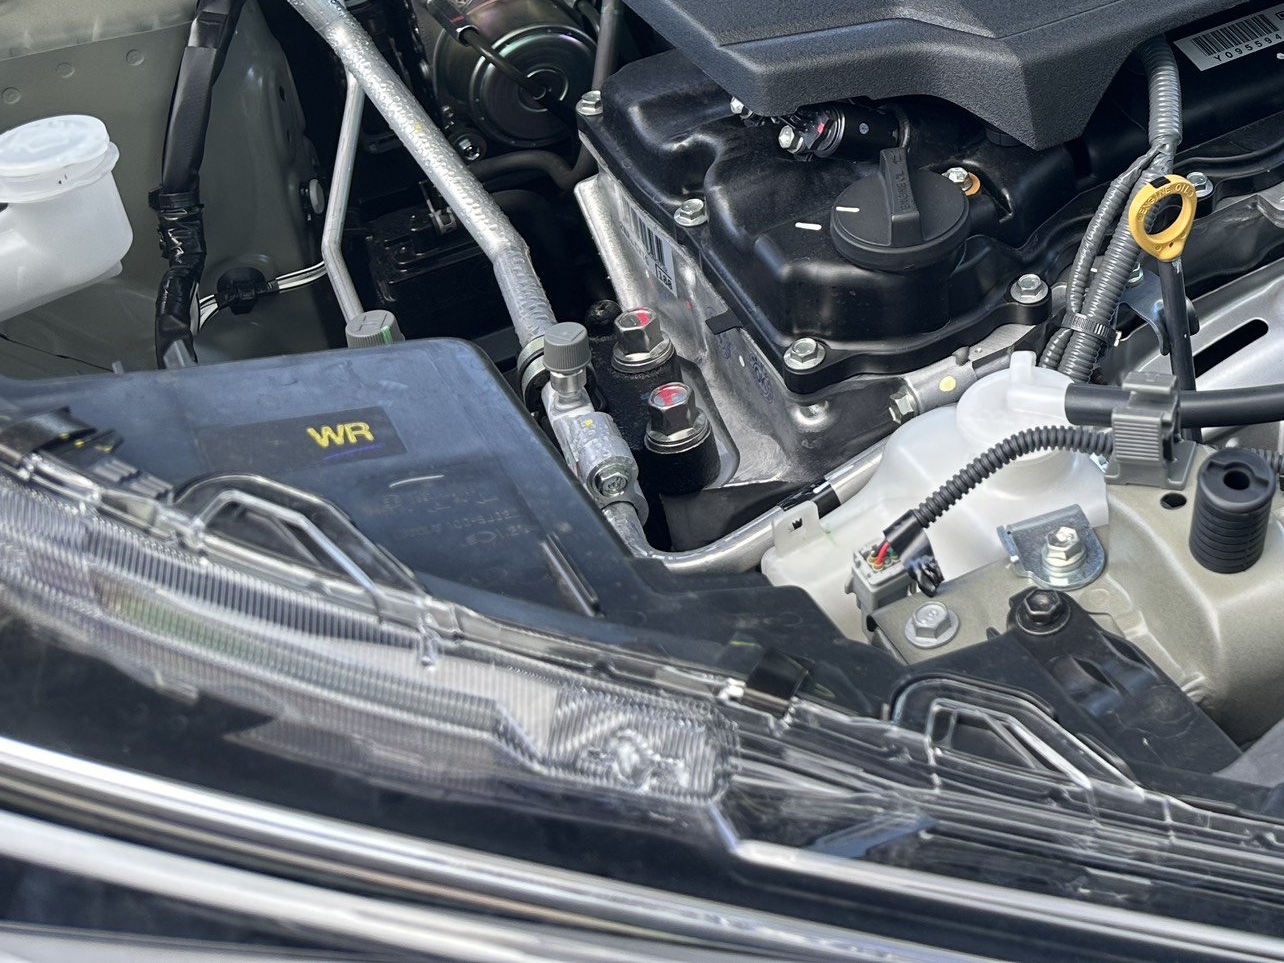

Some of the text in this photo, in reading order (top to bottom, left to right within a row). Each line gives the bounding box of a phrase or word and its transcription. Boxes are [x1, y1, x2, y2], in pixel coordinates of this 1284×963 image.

[1213, 33, 1282, 62] Y095594
[1138, 183, 1190, 215] ENGINE OIL
[306, 421, 375, 448] WR
